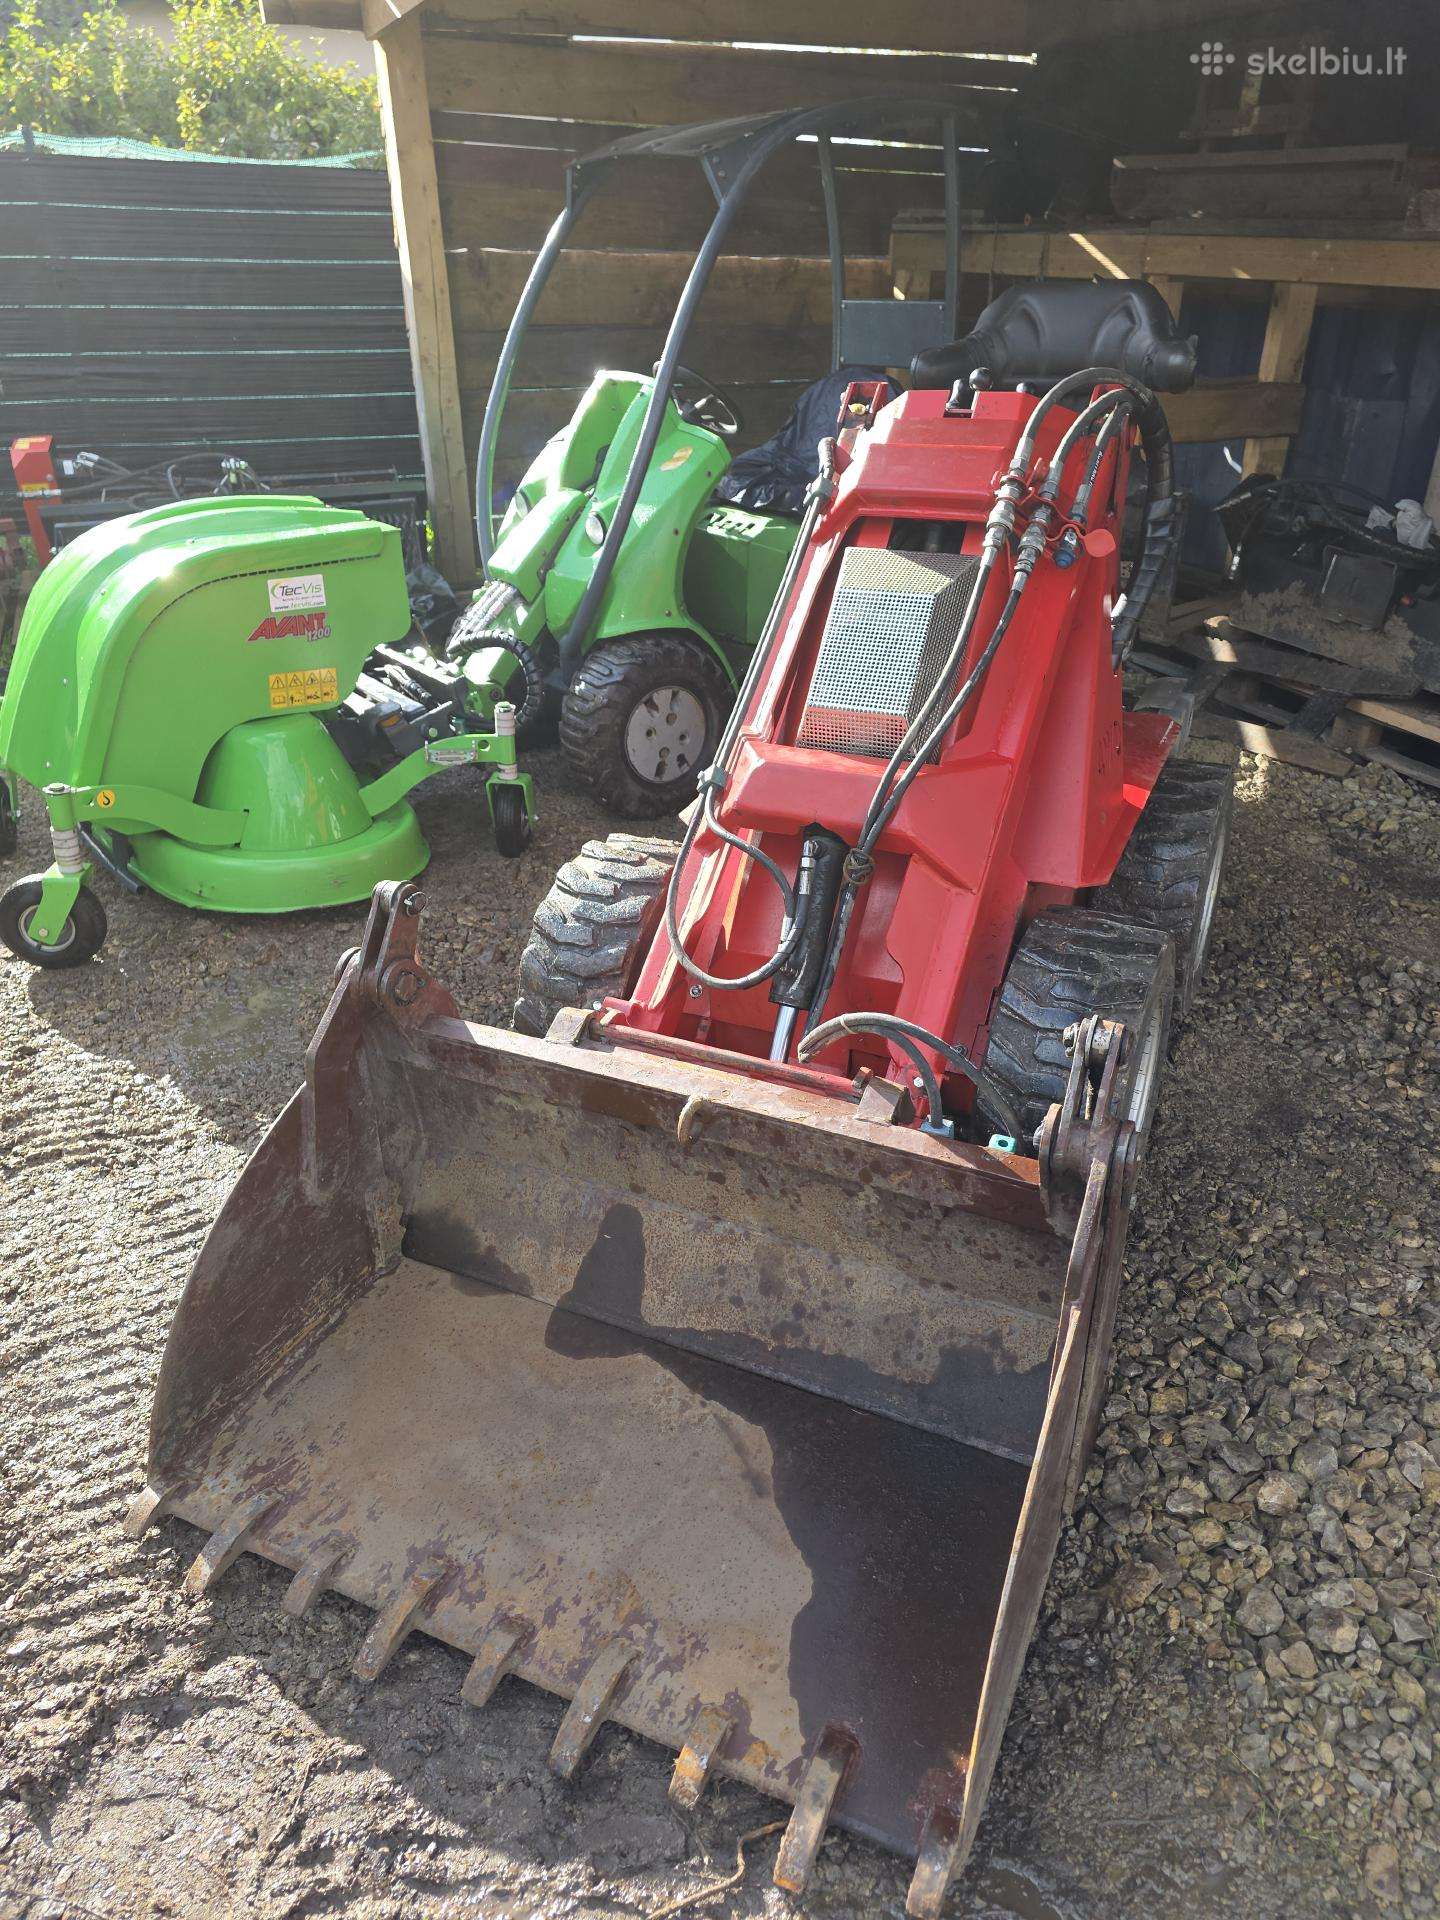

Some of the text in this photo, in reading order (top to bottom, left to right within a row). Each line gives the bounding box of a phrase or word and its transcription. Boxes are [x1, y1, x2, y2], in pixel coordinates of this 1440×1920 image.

[279, 582, 322, 596] TecVis
[247, 612, 326, 641] AVANT
[307, 627, 331, 642] 1200
